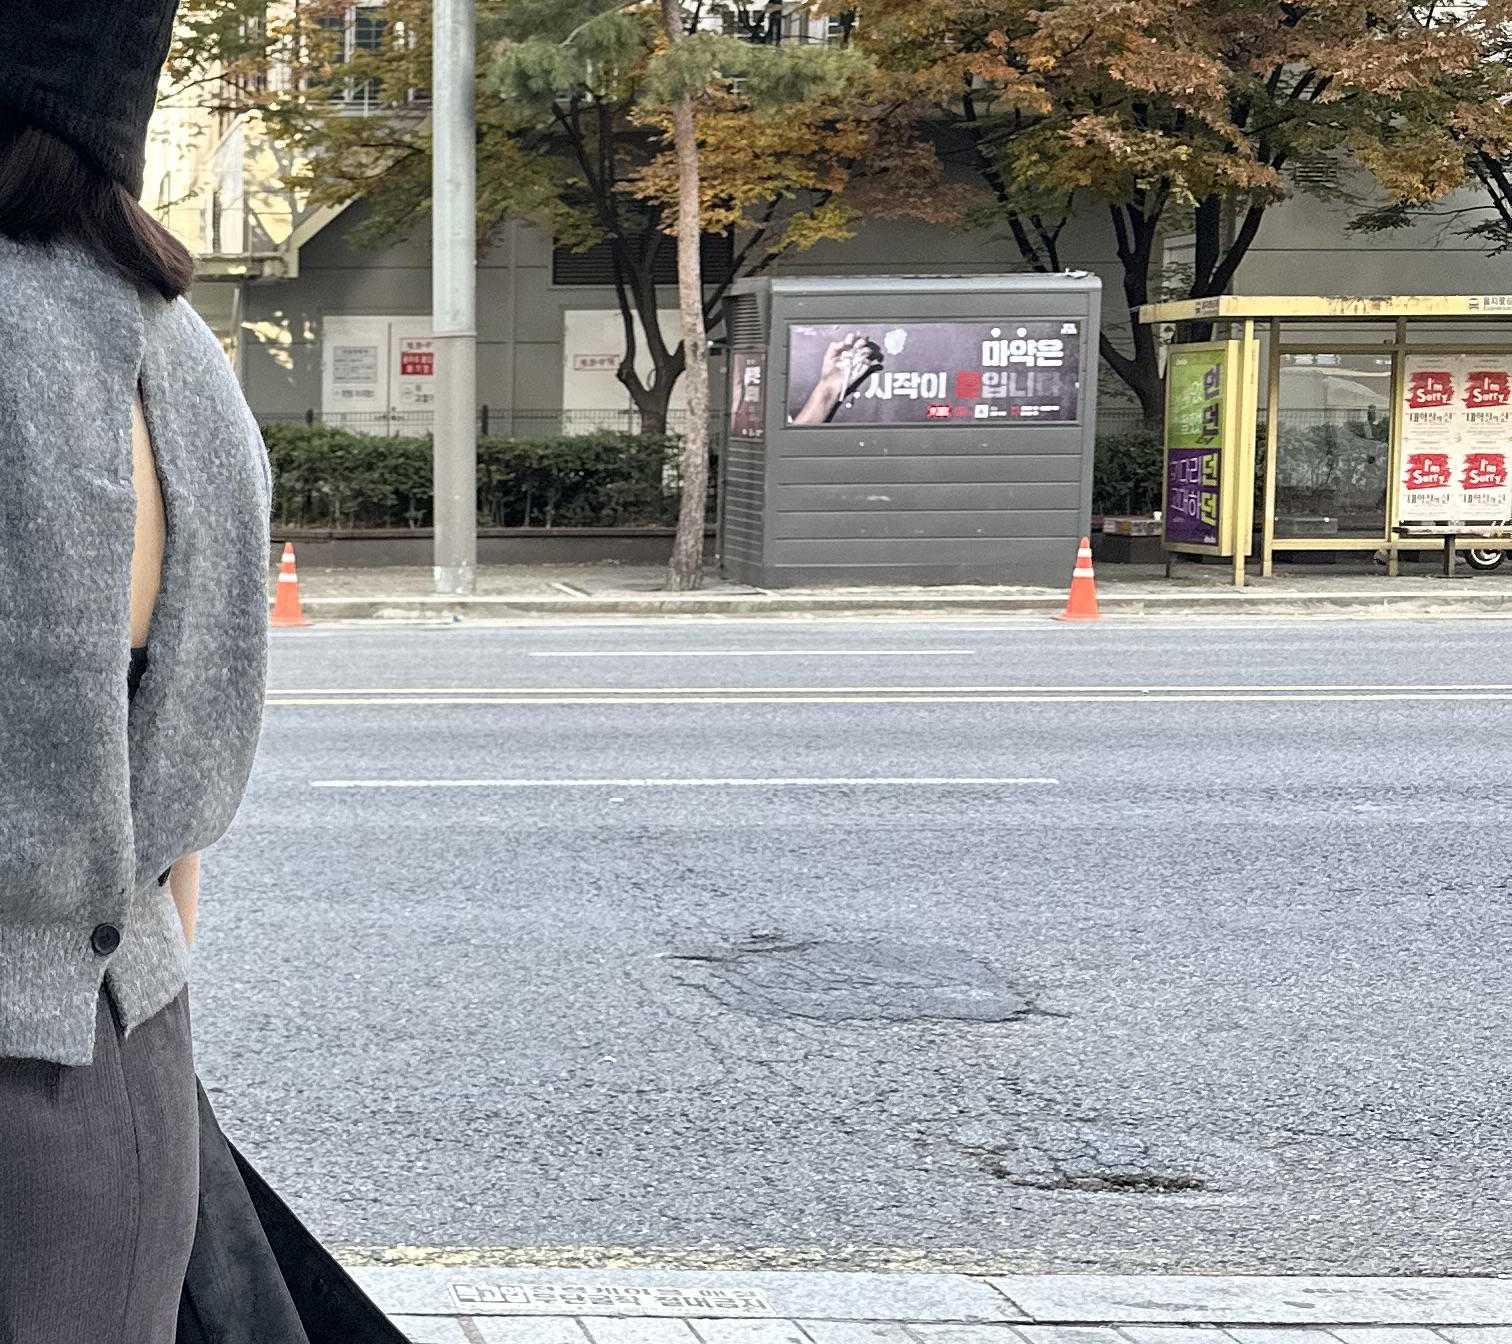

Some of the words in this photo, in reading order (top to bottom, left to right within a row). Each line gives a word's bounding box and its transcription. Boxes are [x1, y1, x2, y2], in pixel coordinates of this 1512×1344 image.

[982, 339, 1064, 367] 마약은
[865, 371, 948, 400] 시작이
[655, 1296, 767, 1310] 절대금지
